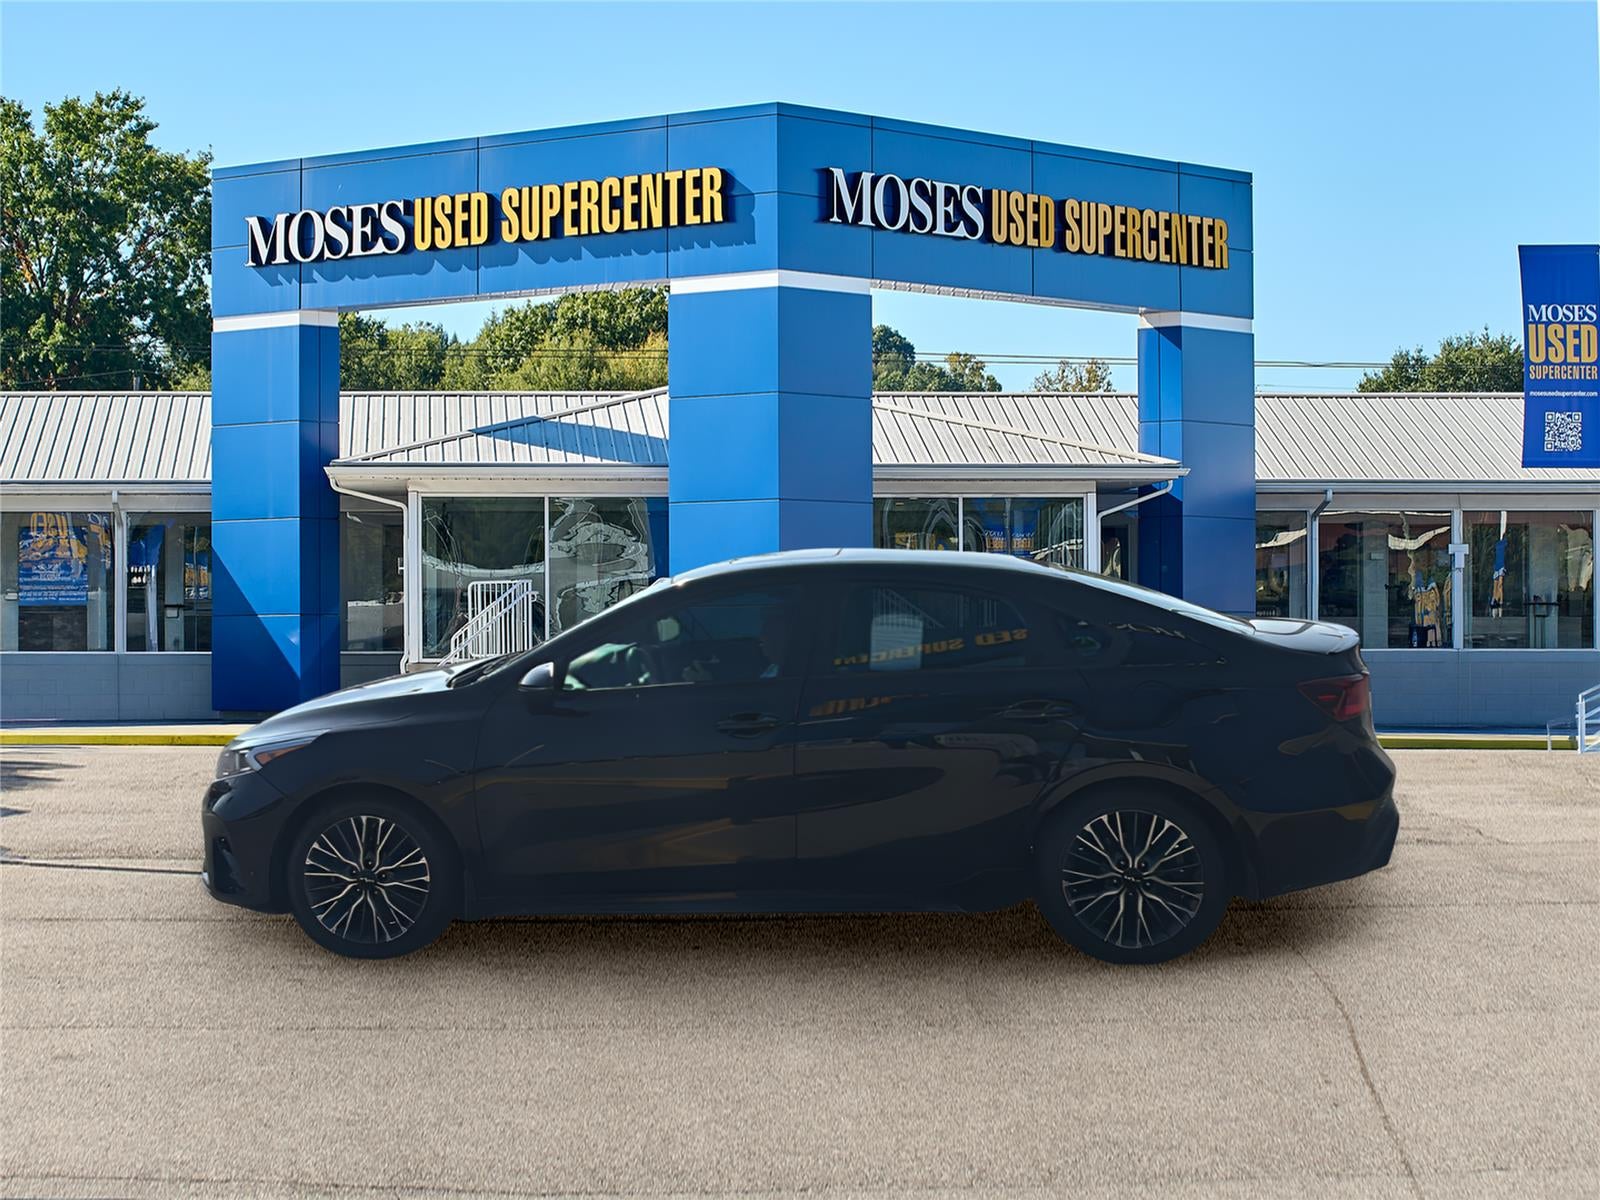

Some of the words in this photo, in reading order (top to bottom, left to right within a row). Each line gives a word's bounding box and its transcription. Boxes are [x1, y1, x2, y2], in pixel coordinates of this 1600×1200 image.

[244, 200, 406, 268] MOSES
[413, 191, 489, 251] USED
[500, 167, 725, 244] SUPERCENTER
[828, 167, 985, 240] MOSES
[991, 188, 1055, 248] USED
[1065, 198, 1229, 269] SUPERCENTER
[1527, 304, 1597, 323] MOSES
[1528, 324, 1598, 363] USED
[1529, 365, 1598, 380] SUPERCENTER
